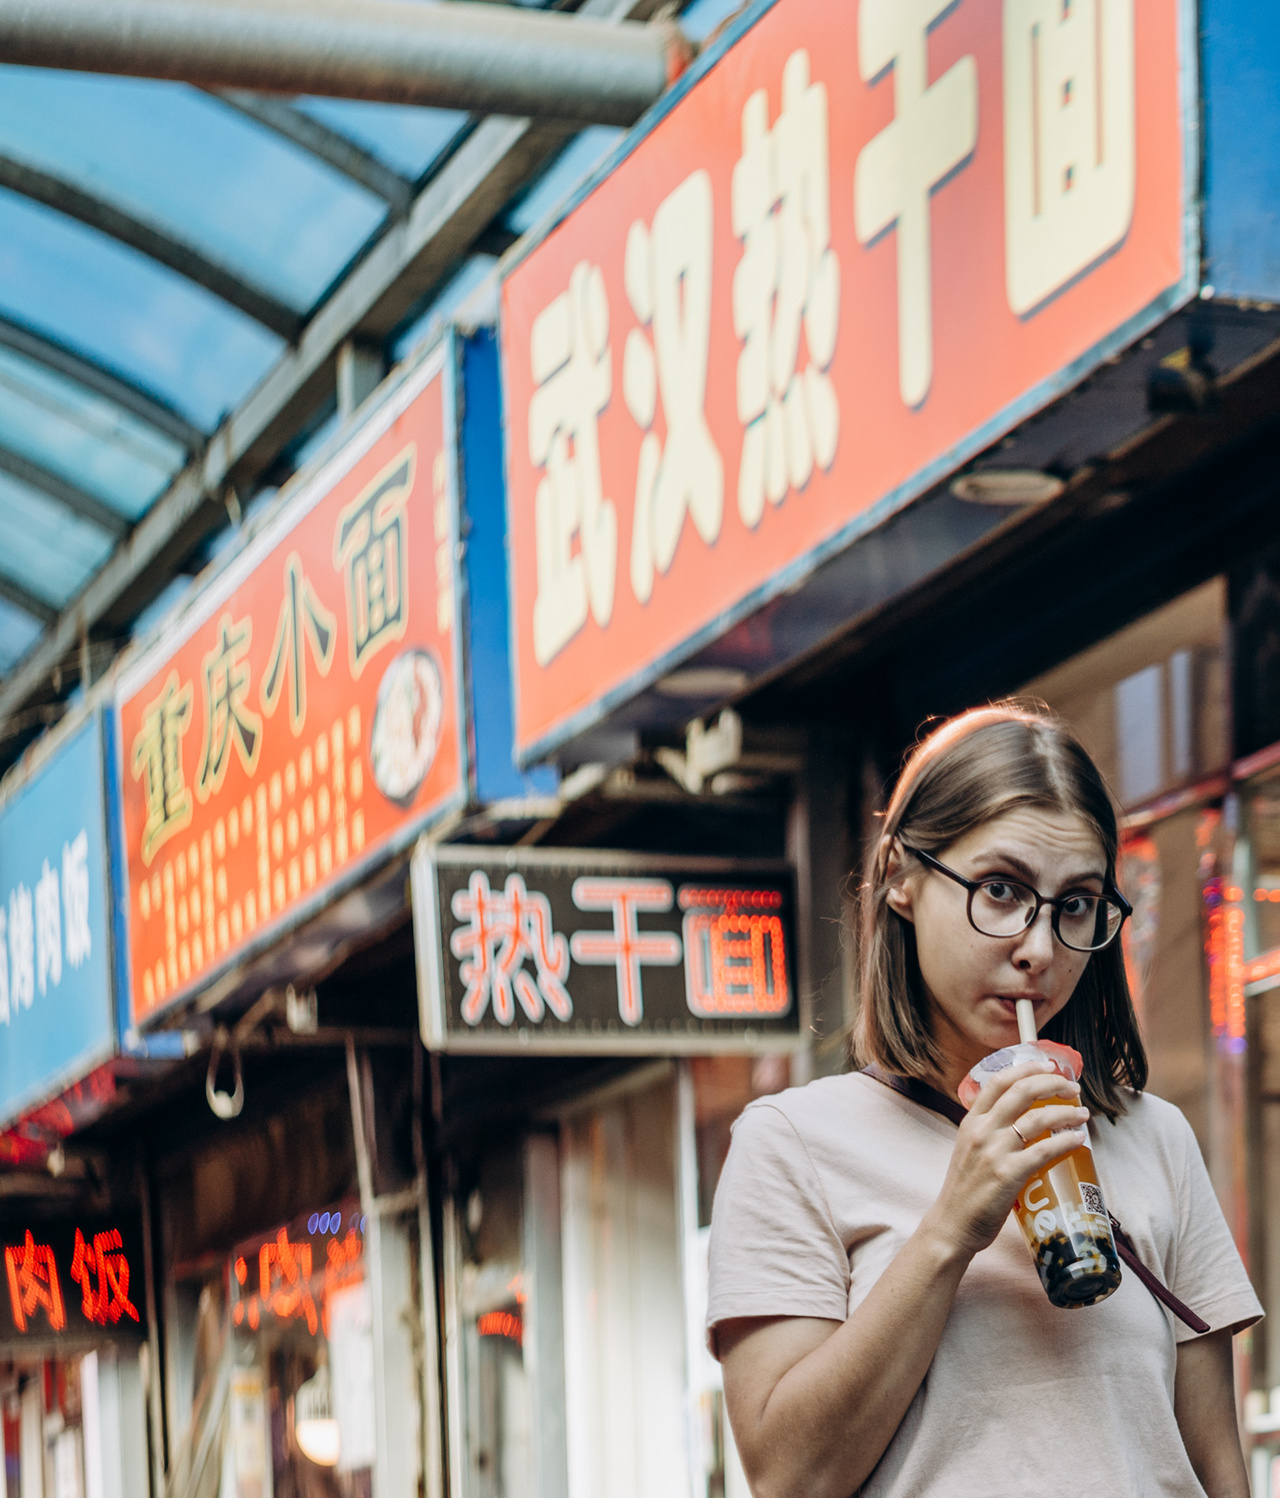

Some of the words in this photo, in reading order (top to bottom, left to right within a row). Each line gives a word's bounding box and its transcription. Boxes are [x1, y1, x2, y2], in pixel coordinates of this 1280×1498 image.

[528, 0, 1137, 667] 武汉热干面
[132, 440, 417, 867] 重庆小面
[451, 870, 792, 1026] 热干面
[5, 1228, 140, 1333] 肉饭
